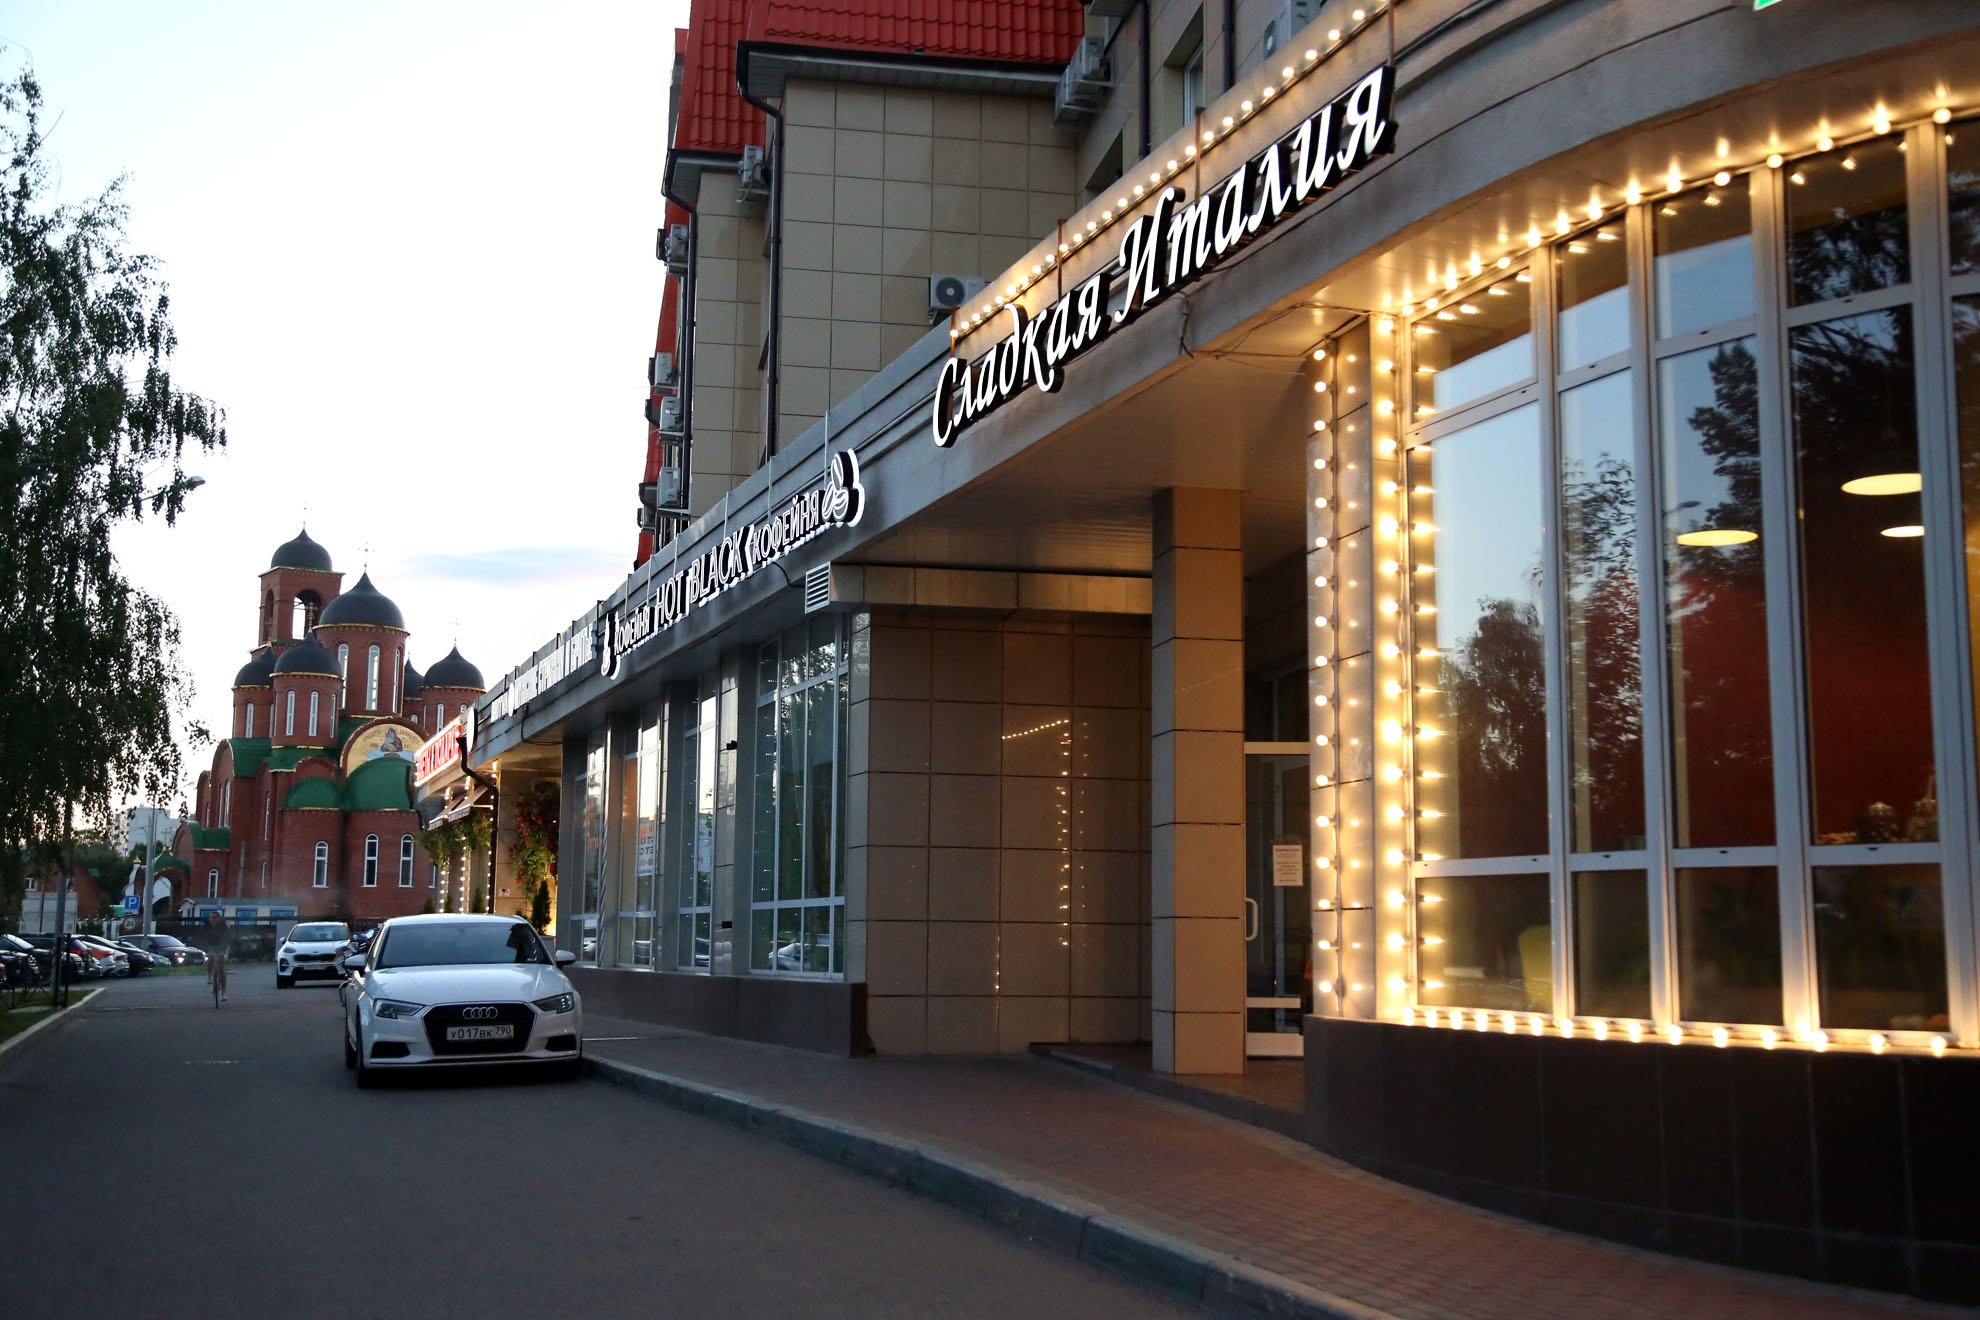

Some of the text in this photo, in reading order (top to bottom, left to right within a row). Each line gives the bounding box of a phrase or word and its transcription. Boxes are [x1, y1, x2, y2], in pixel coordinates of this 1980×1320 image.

[932, 66, 1387, 447] Сладкая Италия
[752, 489, 820, 565] КОФЕЙНЯ
[656, 526, 745, 625] HOT BLACK
[614, 606, 650, 656] КОФЕЙНЯ
[128, 897, 137, 908] P
[495, 1026, 512, 1035] 790
